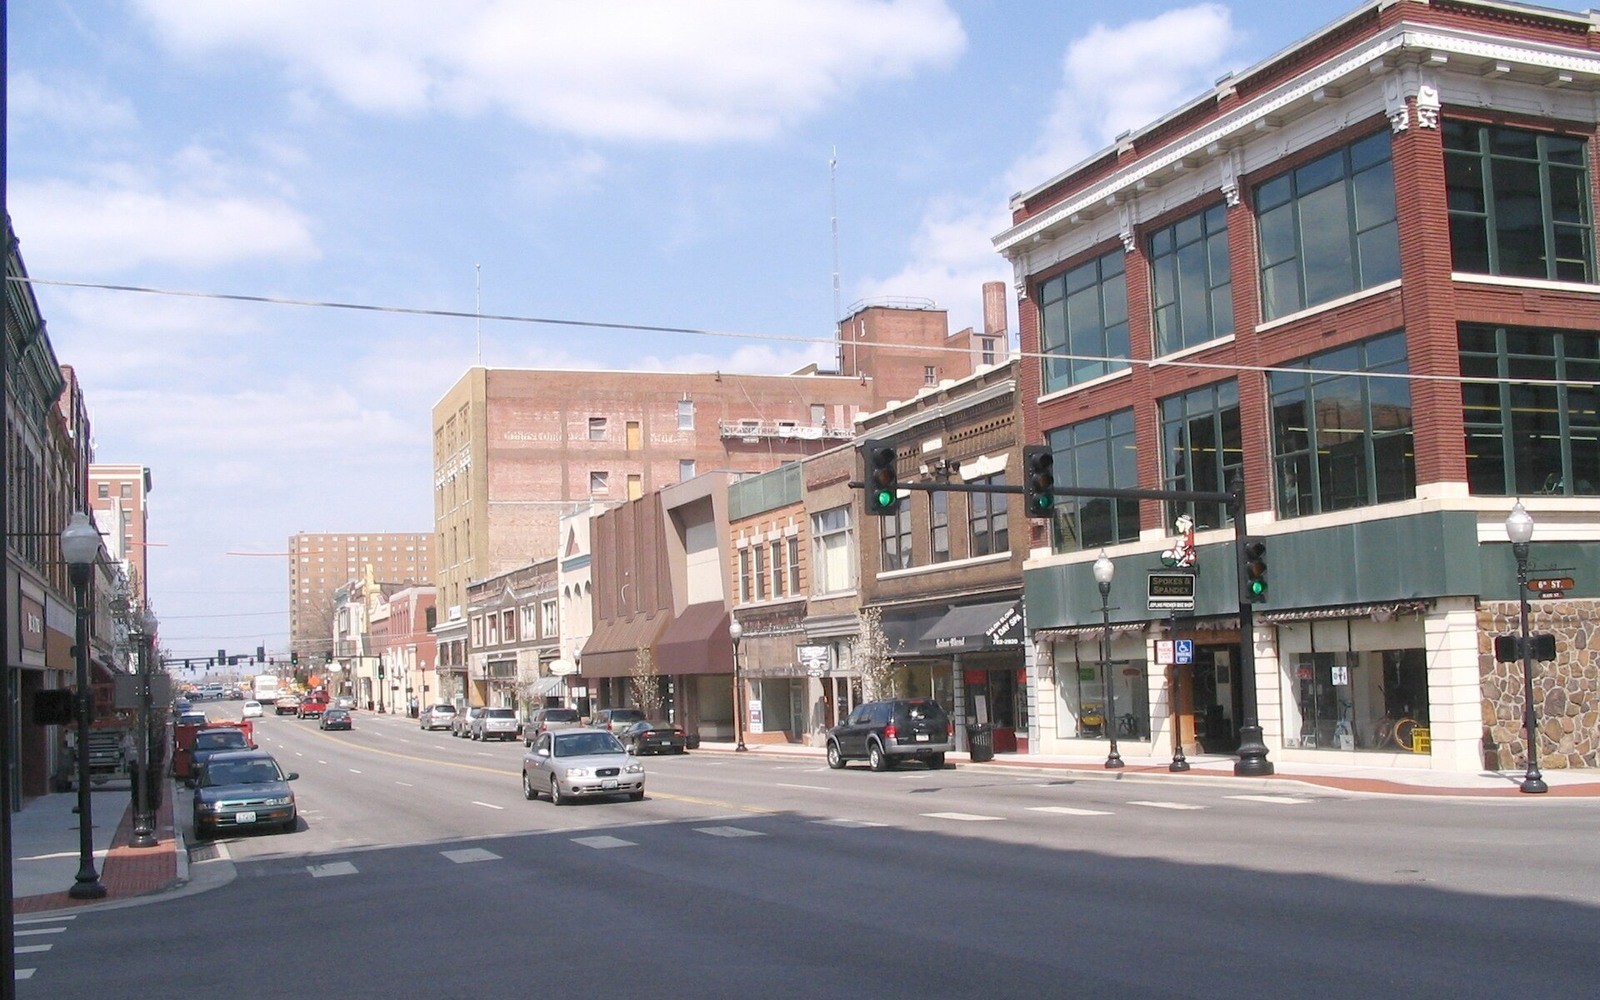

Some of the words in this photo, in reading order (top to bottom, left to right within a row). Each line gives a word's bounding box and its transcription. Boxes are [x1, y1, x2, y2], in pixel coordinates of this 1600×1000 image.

[1152, 577, 1183, 585] SPOKES
[1153, 586, 1189, 594] SPANDEX
[985, 621, 1001, 636] SALON
[997, 622, 1010, 637] DAY
[1009, 613, 1022, 627] SPA
